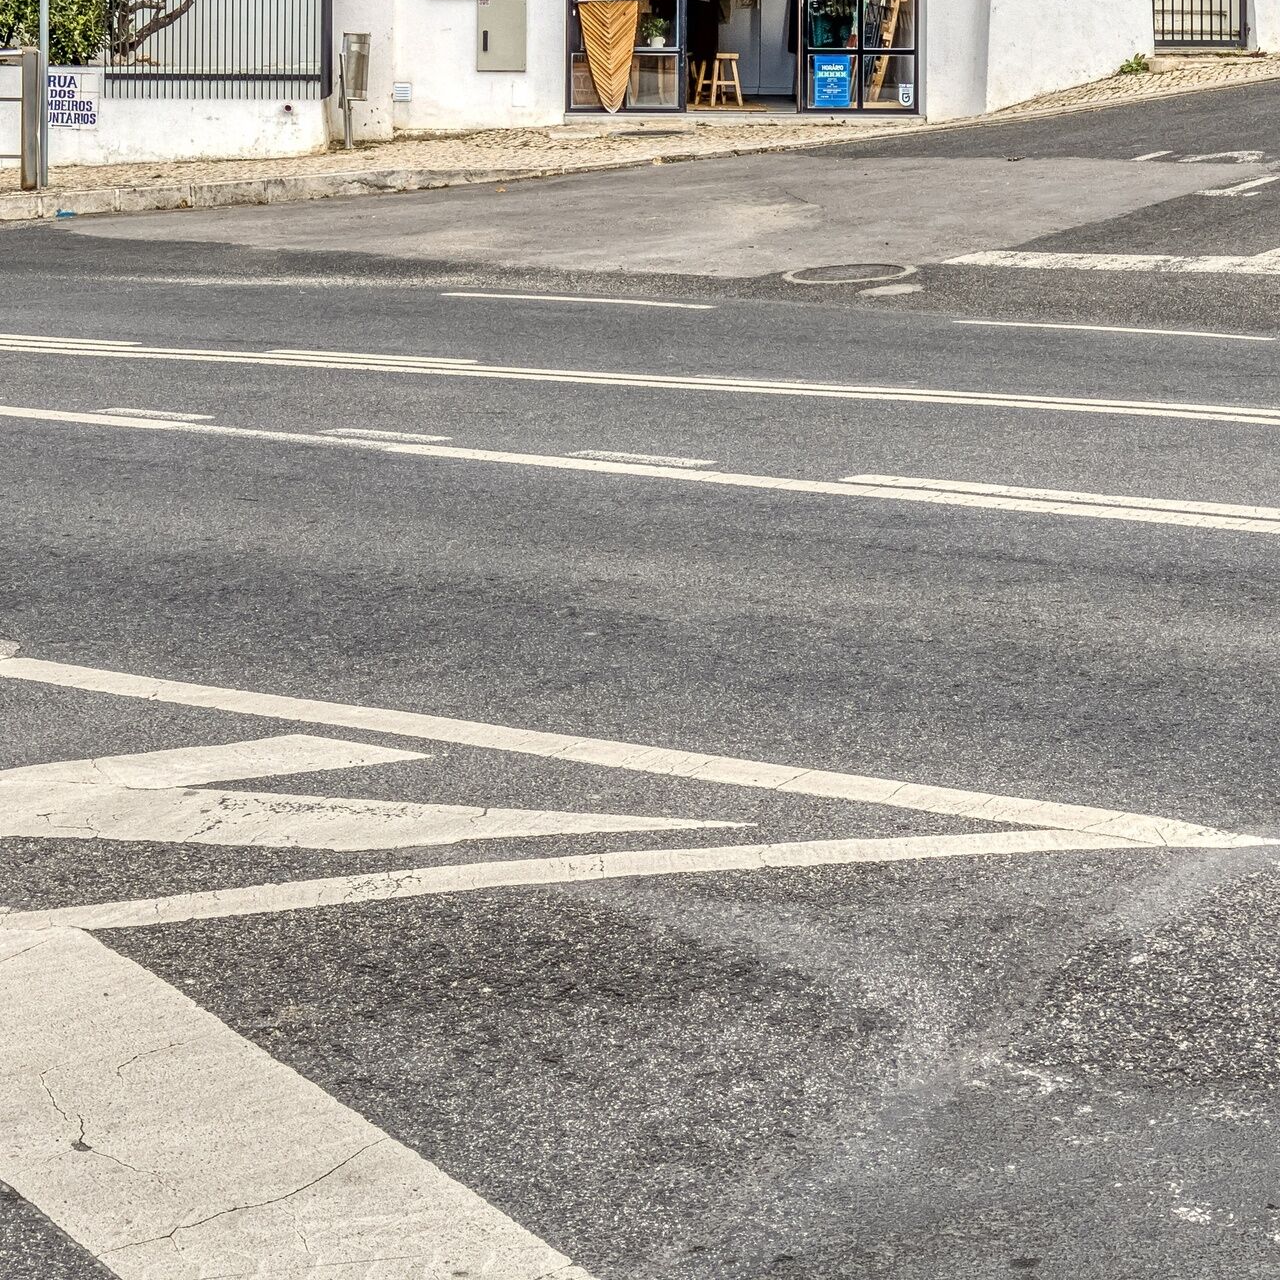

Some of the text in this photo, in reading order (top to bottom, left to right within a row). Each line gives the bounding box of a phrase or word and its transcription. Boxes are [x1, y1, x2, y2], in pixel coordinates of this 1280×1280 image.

[48, 75, 77, 88] RUA
[50, 89, 75, 99] DOS
[48, 100, 93, 111] MBEIROS
[48, 112, 97, 125] UNTARIOS
